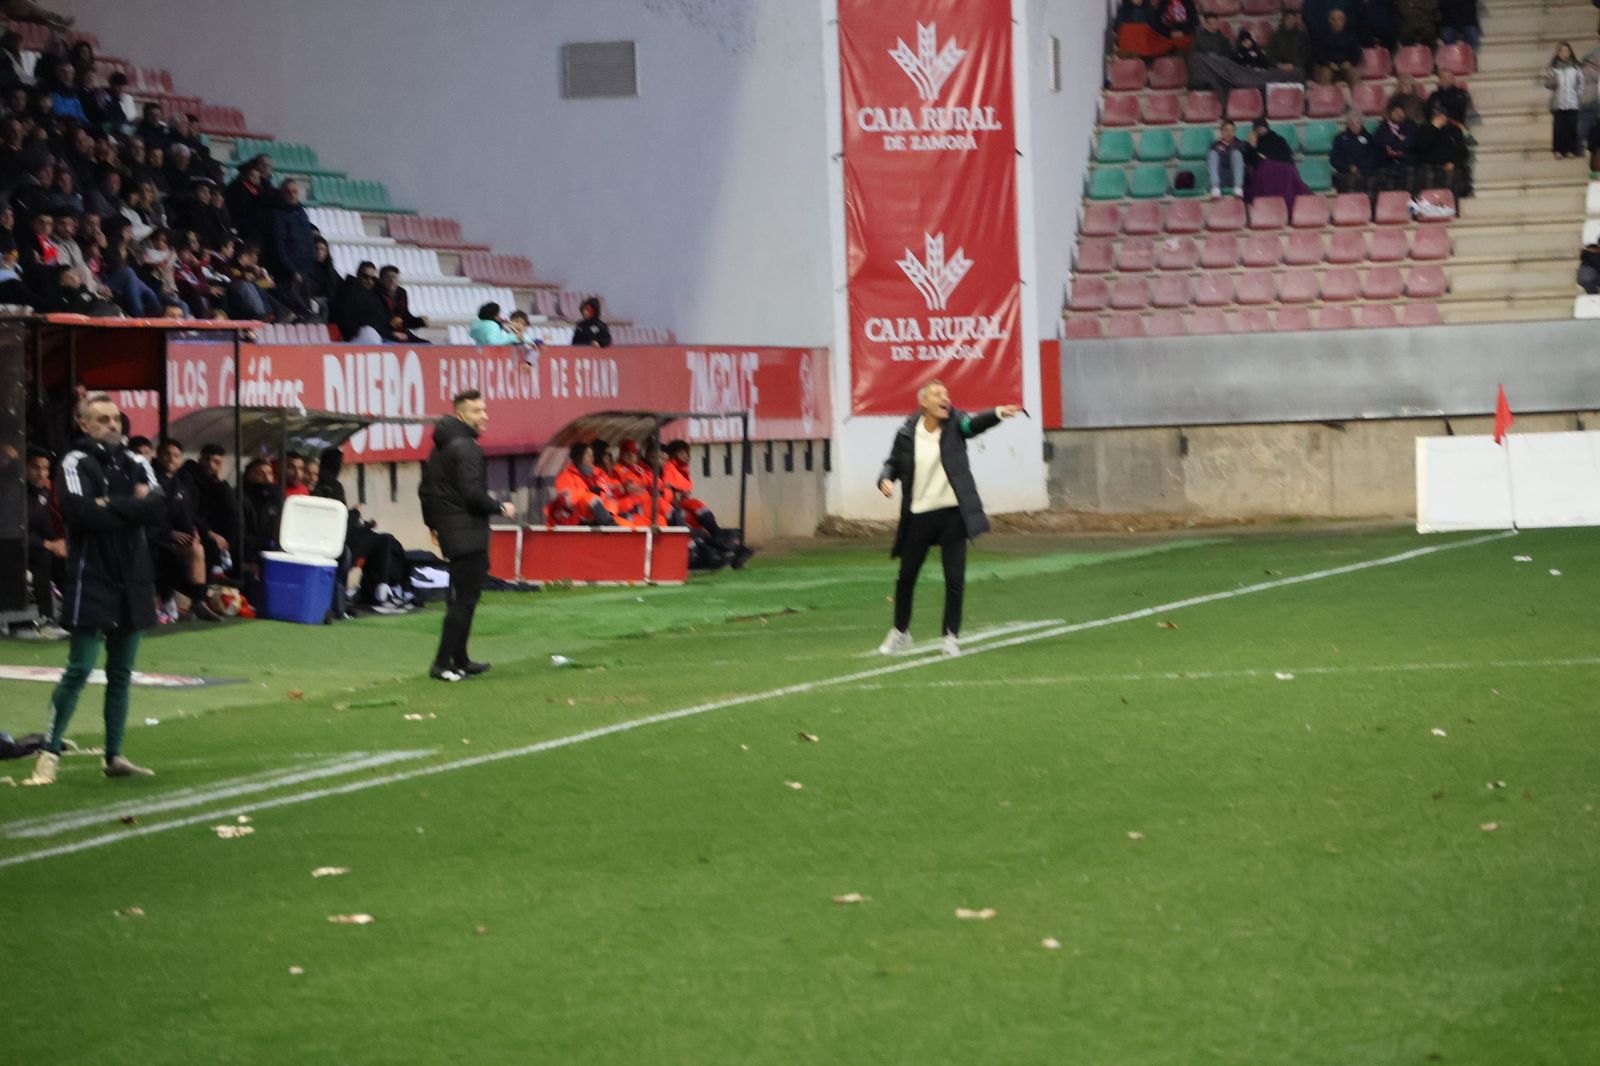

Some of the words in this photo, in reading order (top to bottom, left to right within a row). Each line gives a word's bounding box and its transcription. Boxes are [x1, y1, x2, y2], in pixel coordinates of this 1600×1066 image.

[920, 105, 1002, 132] RURAL
[883, 134, 906, 151] DE
[909, 133, 978, 151] ZAMORA
[927, 314, 1009, 341] RURAL
[890, 345, 914, 362] DE
[916, 344, 984, 361] ZAMORA
[549, 357, 569, 398] DE
